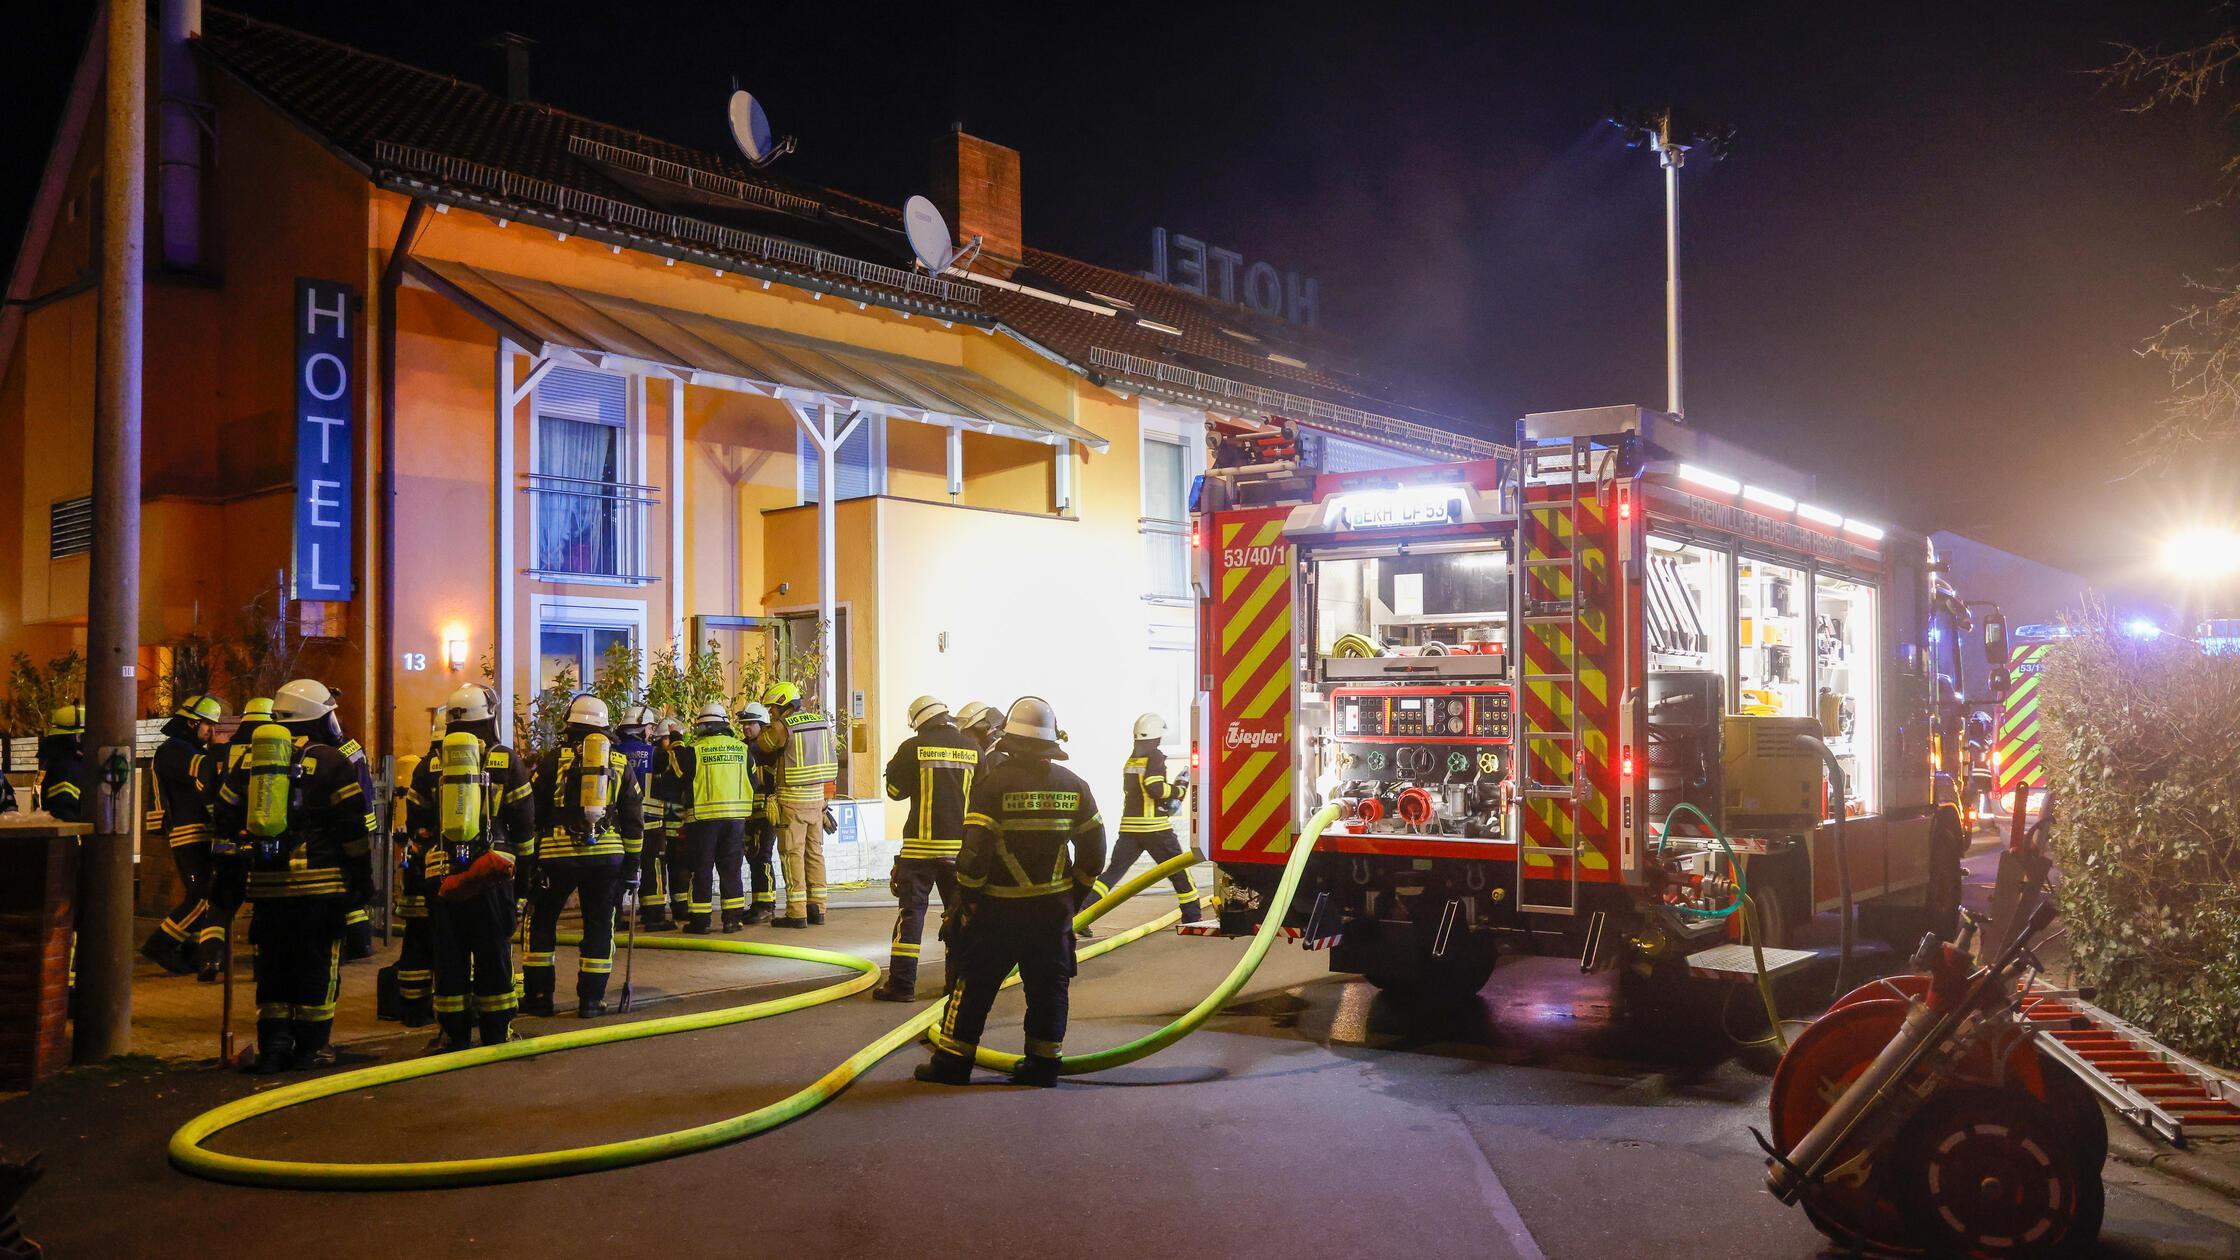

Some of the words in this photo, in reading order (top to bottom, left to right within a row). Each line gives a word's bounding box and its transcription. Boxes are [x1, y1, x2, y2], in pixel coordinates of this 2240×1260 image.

[305, 288, 347, 590] HOTEL
[1426, 503, 1445, 519] 53
[1690, 495, 1757, 536] FREIWILLIGE
[1758, 520, 1809, 550] FEUERWEHR
[1223, 544, 1286, 568] 53/40/1
[404, 653, 426, 671] 13
[2020, 663, 2042, 673] 53/1
[787, 716, 799, 724] UG
[1226, 722, 1282, 748] Ziegler
[919, 747, 951, 759] Feuerwehr
[952, 750, 977, 763] Heßdorf
[1004, 792, 1079, 801] FEUERWEHR
[1007, 801, 1076, 810] HESSDORF
[845, 808, 853, 825] P
